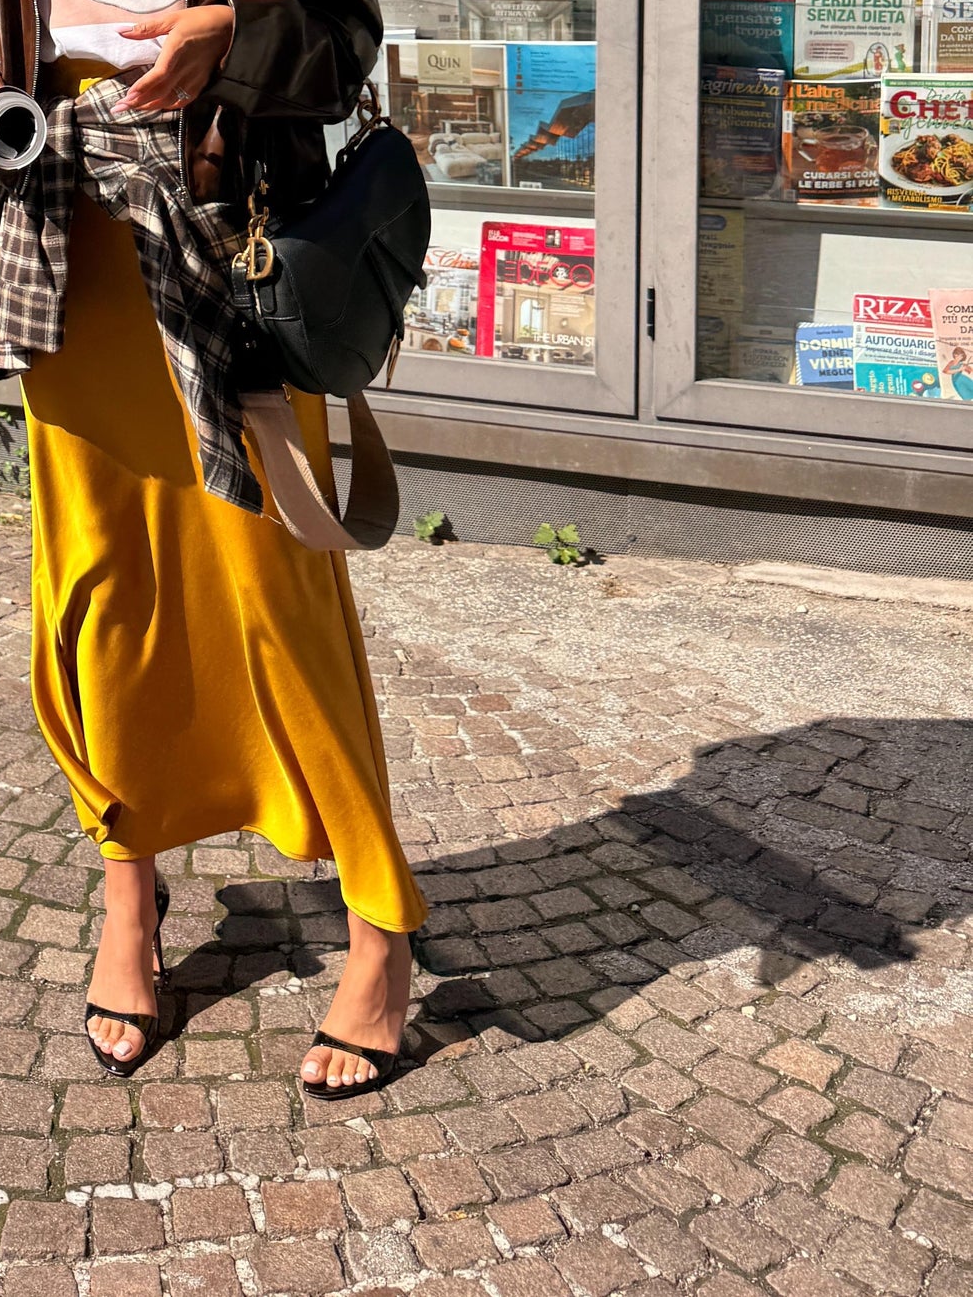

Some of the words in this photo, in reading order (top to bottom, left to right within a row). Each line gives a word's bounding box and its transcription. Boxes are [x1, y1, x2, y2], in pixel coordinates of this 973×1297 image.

[715, 13, 783, 26] pensare
[807, 8, 857, 22] SENZA
[862, 9, 905, 24] DIETA
[735, 24, 783, 39] troppo
[940, 34, 955, 42] DA
[427, 54, 461, 72] QUIN
[796, 84, 845, 99] L'altra
[802, 170, 850, 179] CURARSI
[854, 170, 877, 179] CON
[798, 180, 811, 189] LE
[814, 180, 843, 189] ERBE
[845, 179, 856, 188] SI
[855, 296, 926, 320] RIZA
[865, 335, 935, 350] AUTOGUARIG
